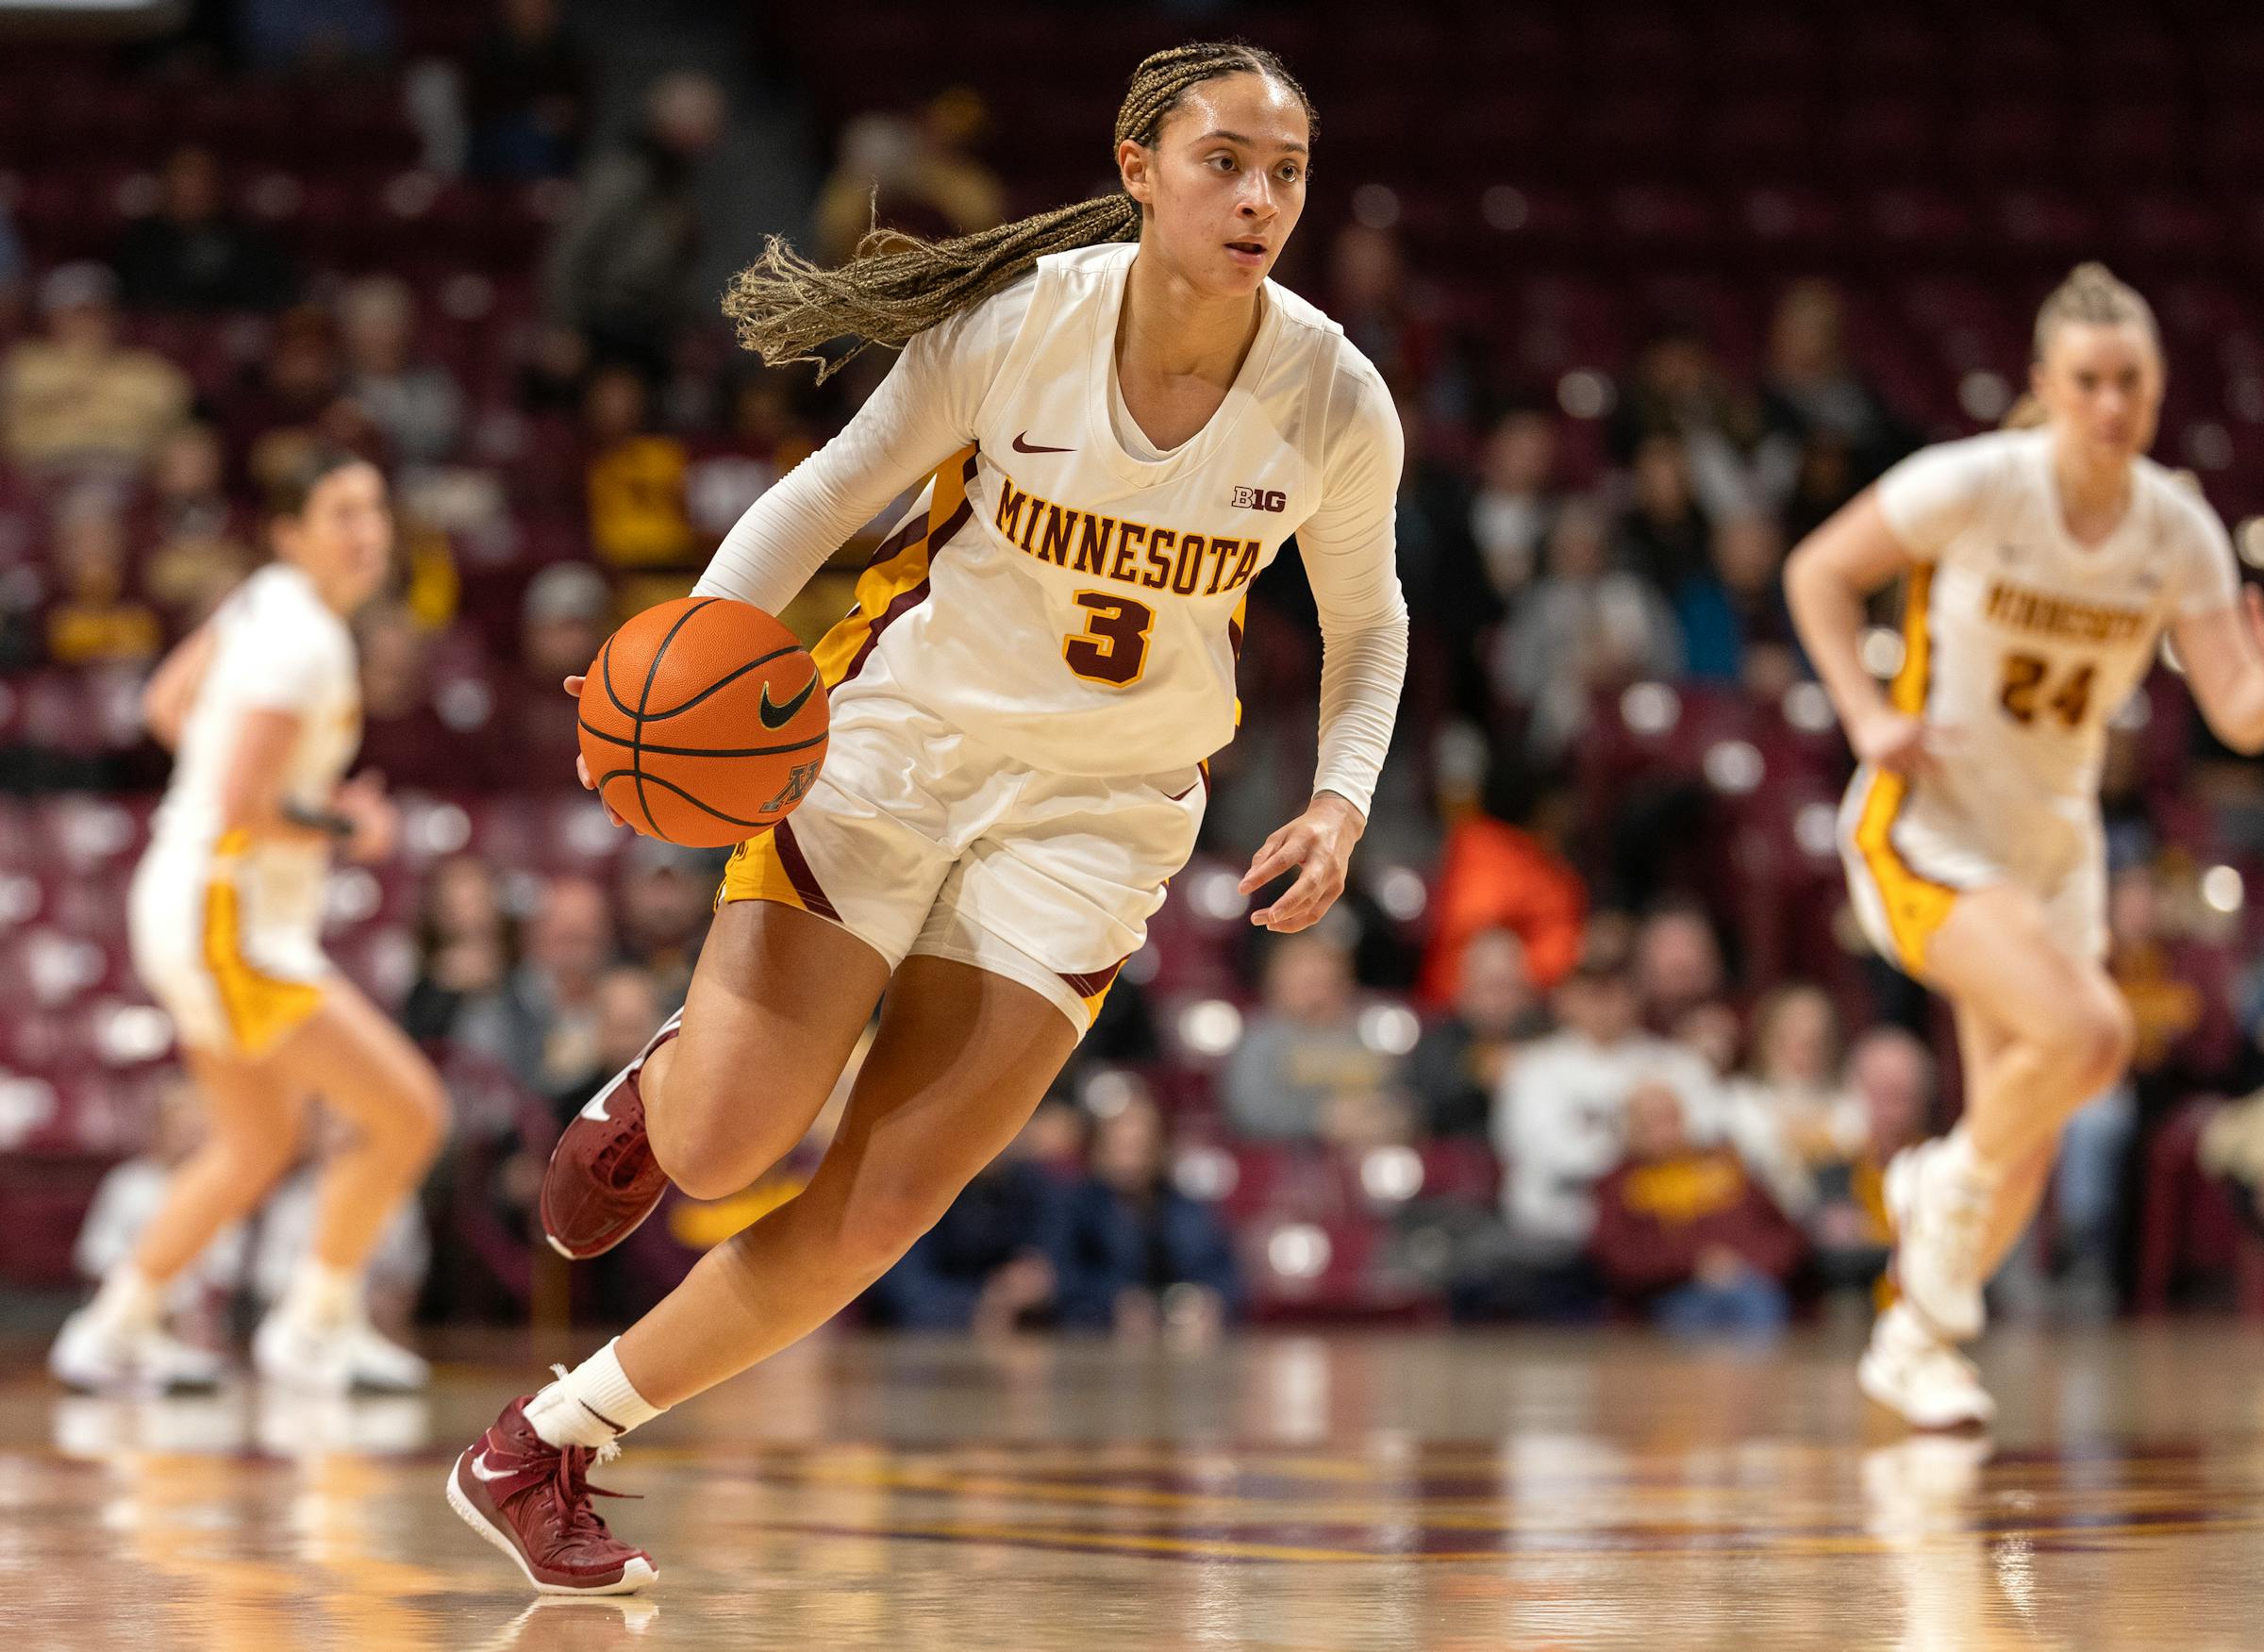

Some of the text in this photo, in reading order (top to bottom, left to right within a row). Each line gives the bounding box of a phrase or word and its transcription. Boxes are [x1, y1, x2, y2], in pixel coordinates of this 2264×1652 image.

[995, 475, 1262, 596] MINNESOTA
[1061, 588, 1157, 689] 3
[1998, 650, 2097, 726] 24
